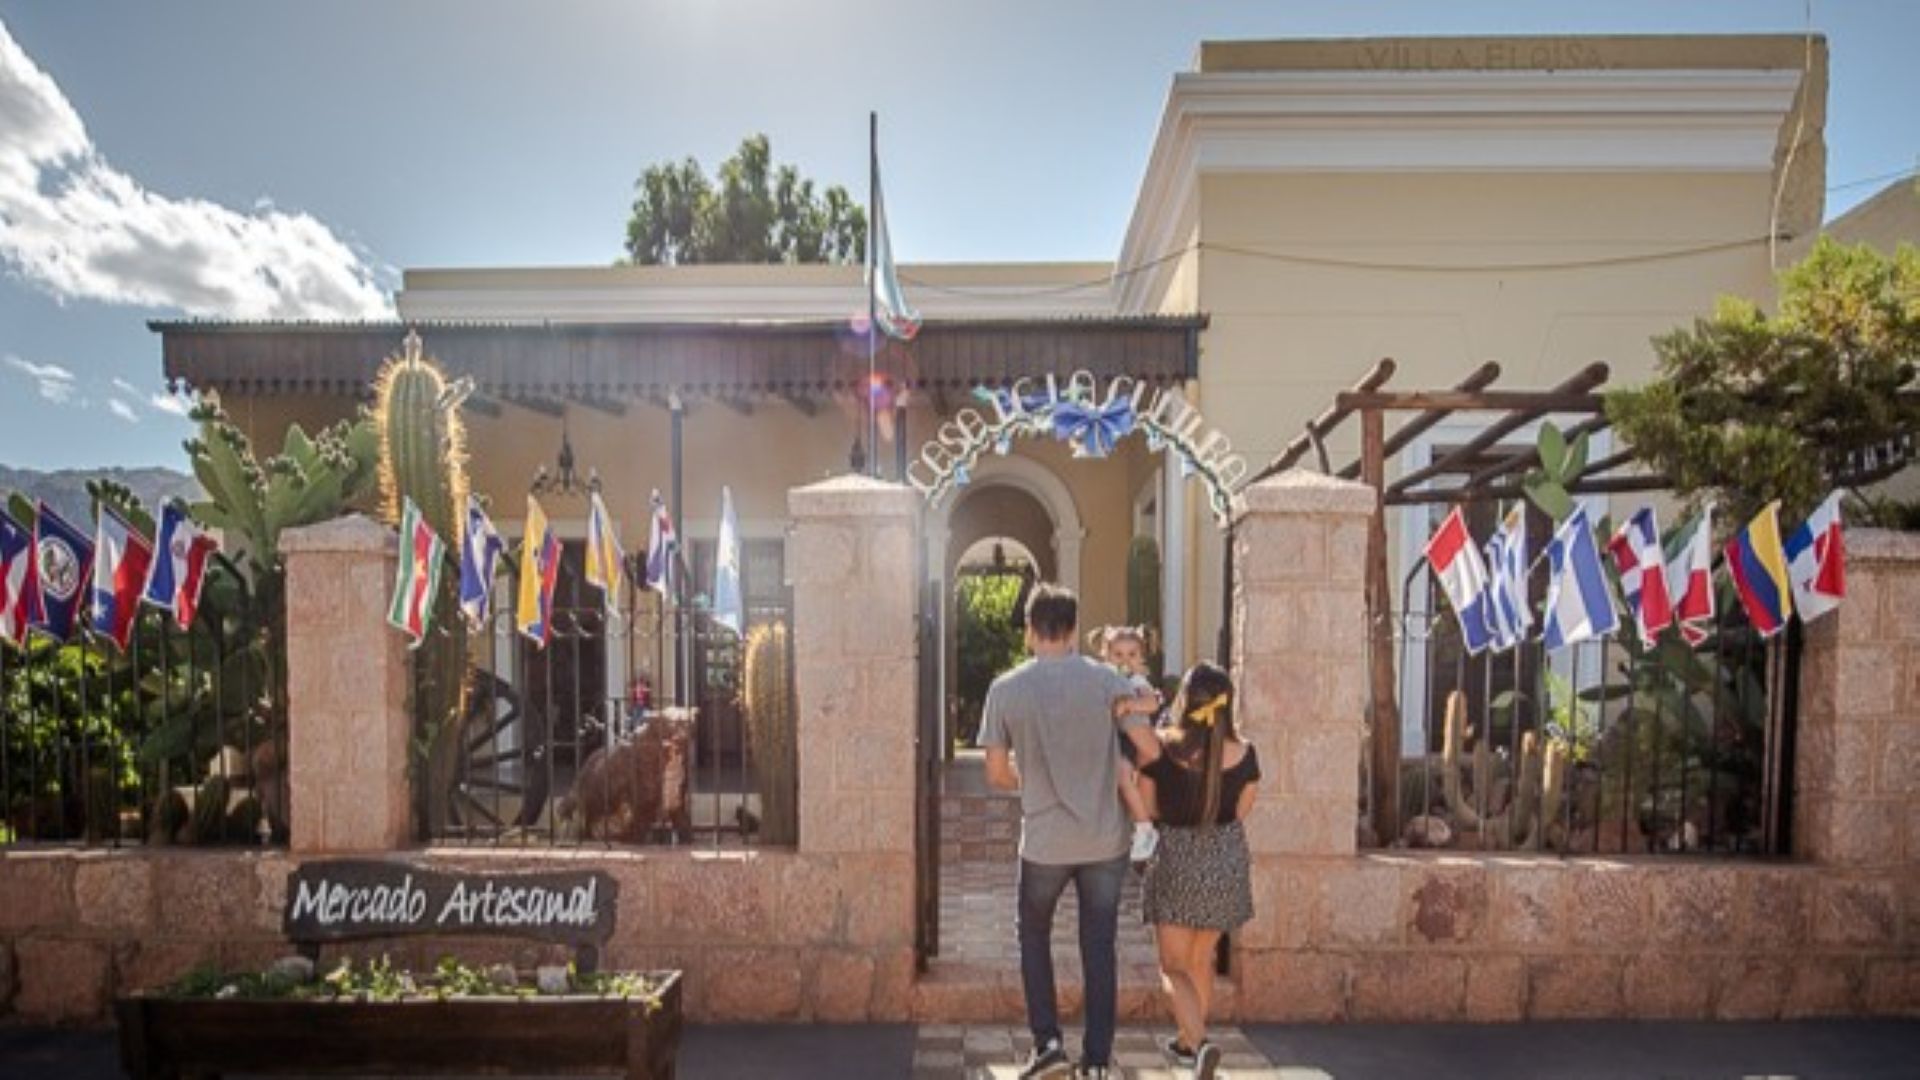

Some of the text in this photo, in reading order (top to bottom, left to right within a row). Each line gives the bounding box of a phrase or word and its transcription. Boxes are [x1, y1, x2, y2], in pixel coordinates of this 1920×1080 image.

[905, 407, 984, 492] CASA
[292, 875, 598, 925] Mercado Artesanal
